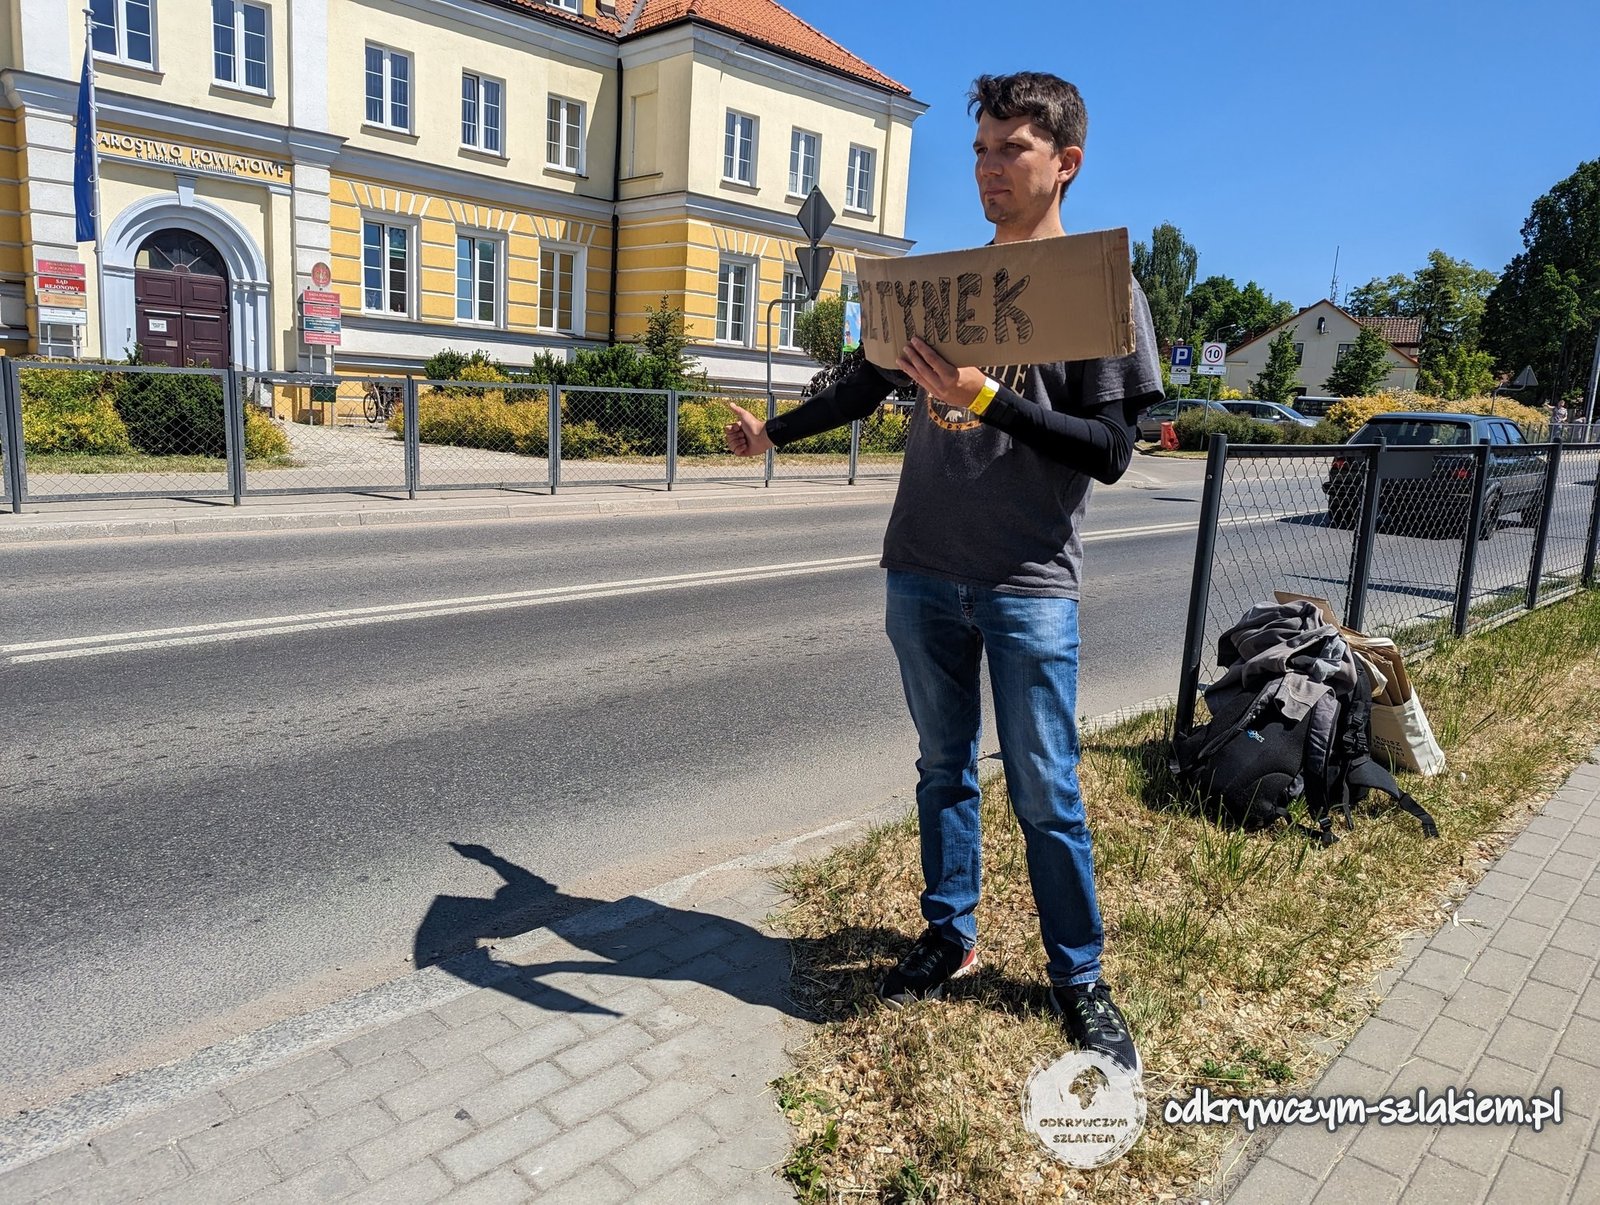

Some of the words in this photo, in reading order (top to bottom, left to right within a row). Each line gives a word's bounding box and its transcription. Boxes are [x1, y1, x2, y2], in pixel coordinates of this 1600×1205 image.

[97, 132, 183, 158] AROSTWO
[191, 148, 284, 176] POWIATOWE
[44, 283, 80, 291] REJONOWY
[1175, 348, 1189, 364] P
[1207, 349, 1220, 359] 10
